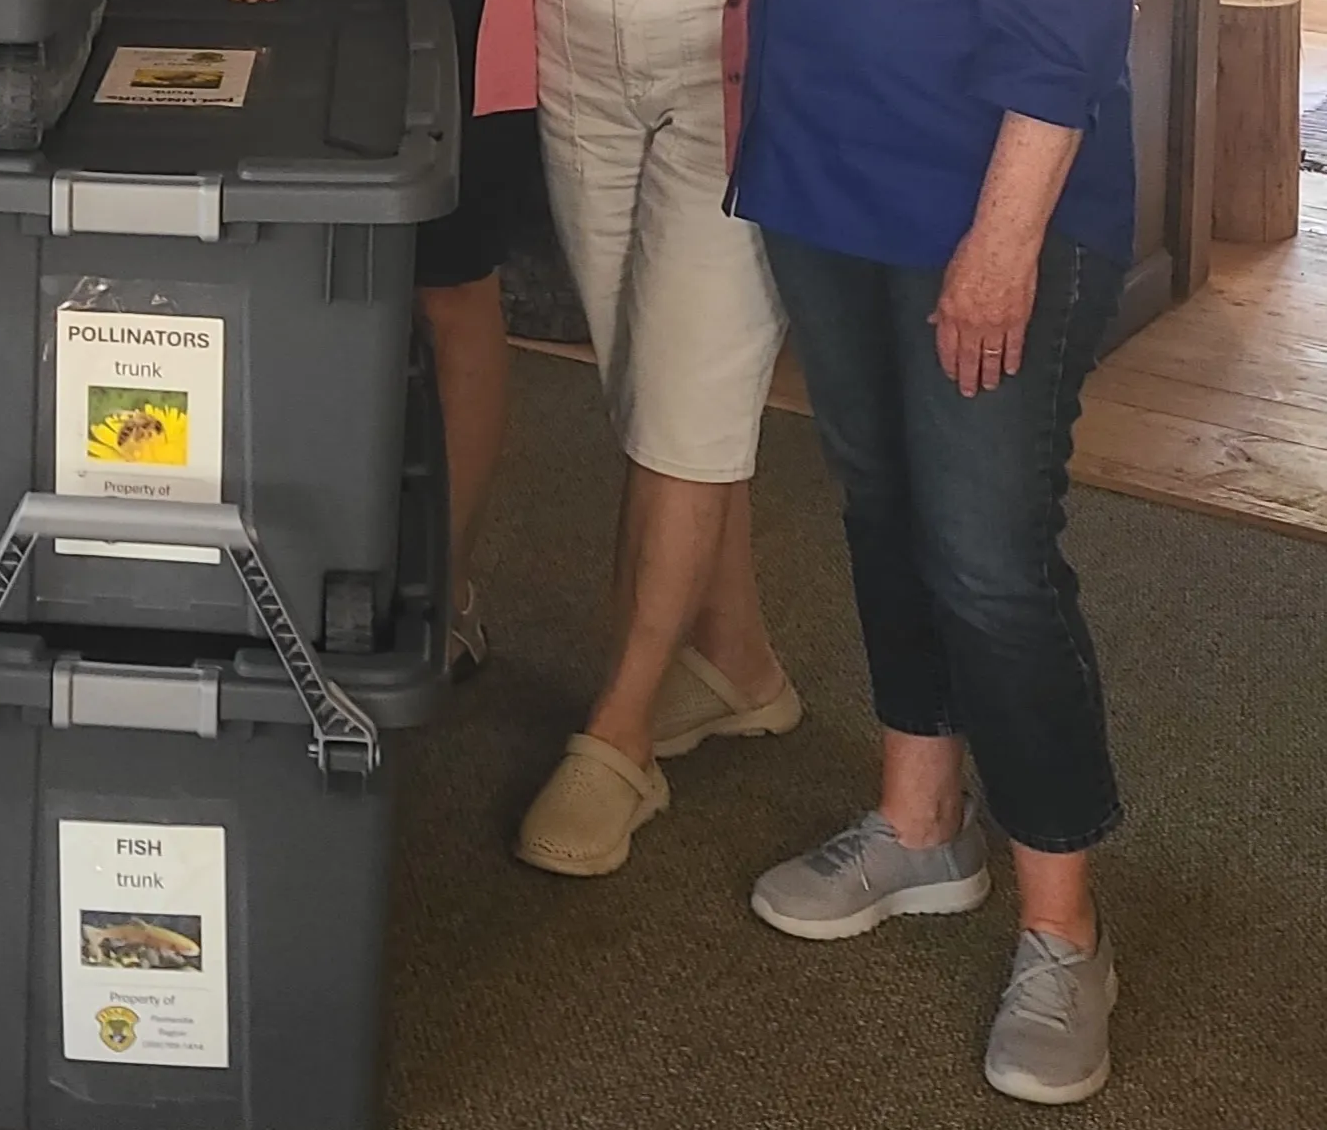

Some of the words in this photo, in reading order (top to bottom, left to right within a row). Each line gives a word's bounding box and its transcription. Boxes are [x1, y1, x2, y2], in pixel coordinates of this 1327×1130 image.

[68, 325, 210, 349] POLLINATORS
[114, 360, 162, 378] trunk
[104, 481, 155, 497] Property
[158, 484, 171, 496] of
[116, 838, 163, 857] FISH
[116, 872, 164, 889] trunk
[109, 991, 160, 1006] Property
[163, 994, 176, 1005] of
